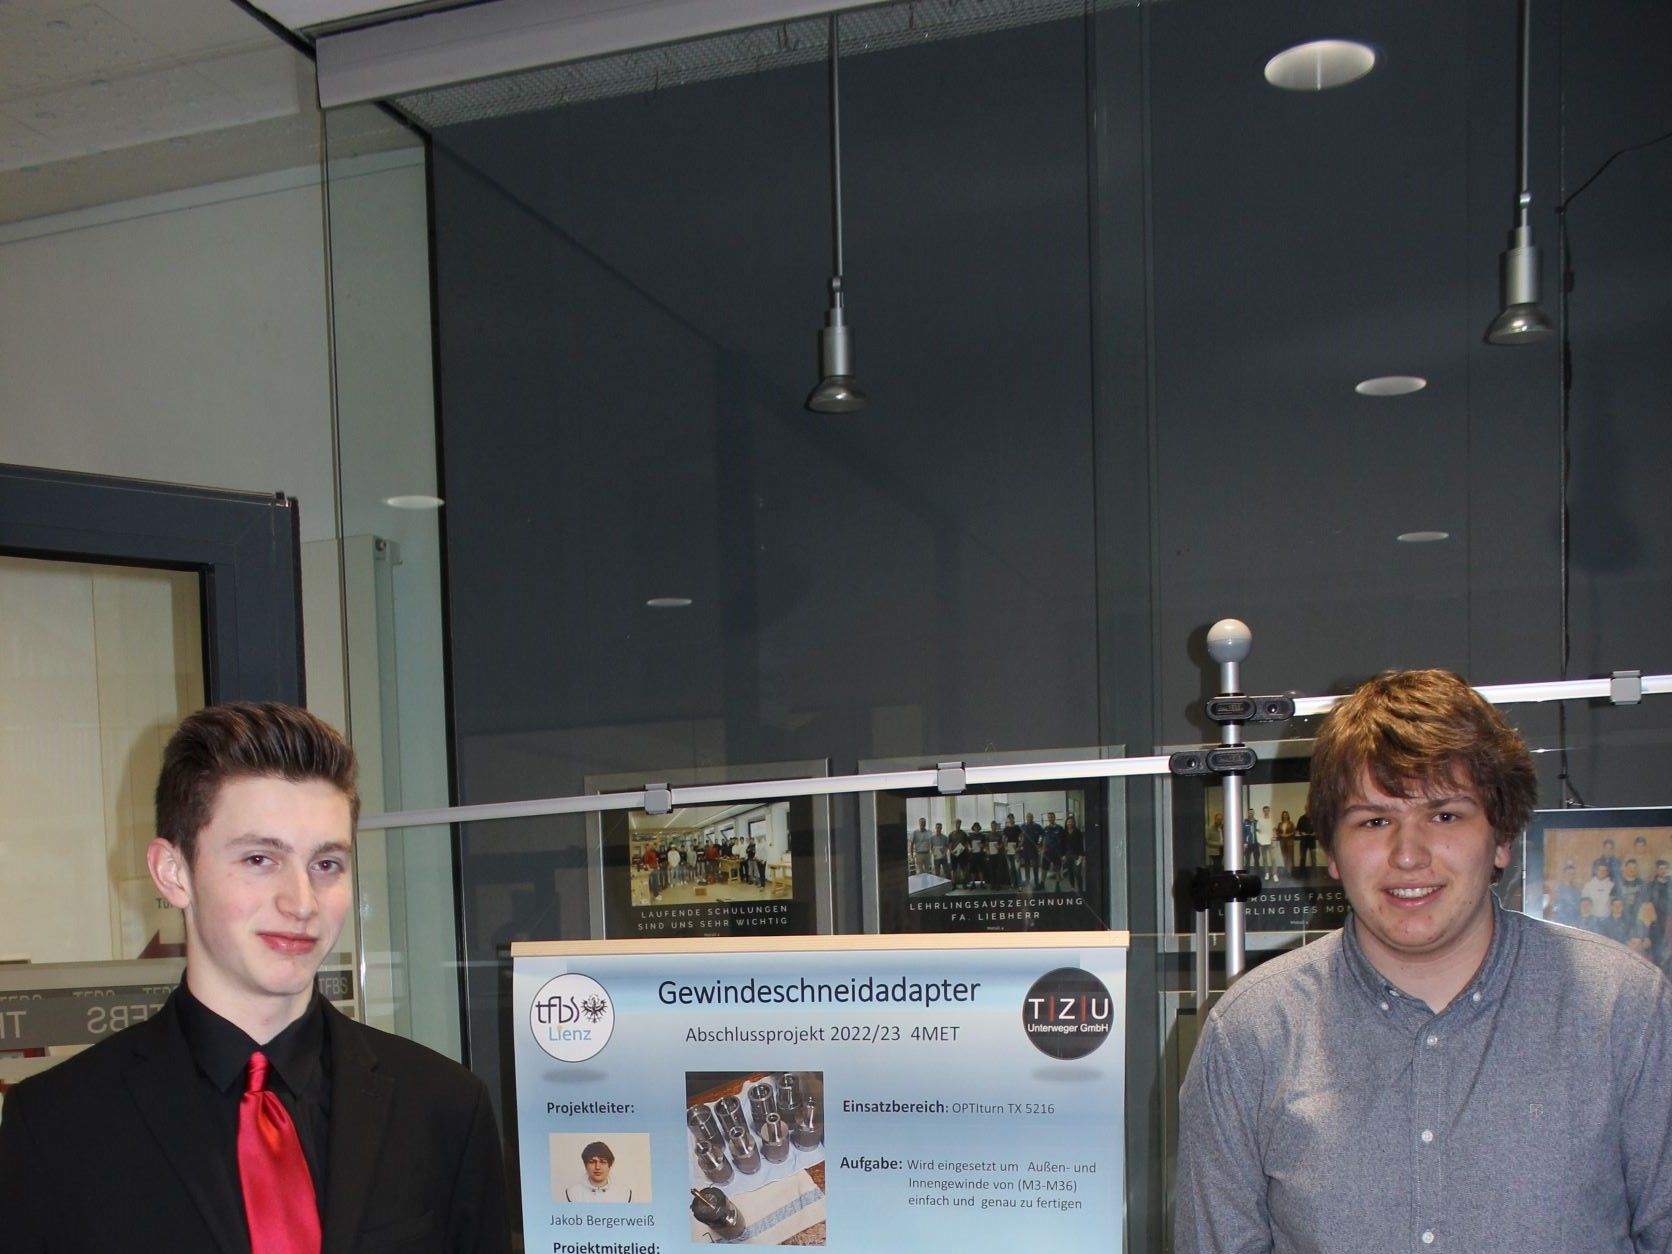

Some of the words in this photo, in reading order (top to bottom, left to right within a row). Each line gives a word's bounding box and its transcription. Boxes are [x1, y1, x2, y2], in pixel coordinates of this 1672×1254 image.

[641, 908, 701, 919] LAUFENDE
[707, 905, 788, 916] SCHULUNGEN
[909, 897, 1083, 911] LEHRLINGSAUSZEICHNUNG
[1293, 905, 1319, 915] DES
[637, 922, 665, 931] SIND
[671, 920, 694, 930] UNS
[700, 919, 730, 928] SEHR
[736, 917, 788, 927] WICHTIG
[951, 913, 971, 922] FA.
[978, 911, 1041, 921] LIEBHERR
[658, 976, 981, 1007] Gewindeschneidadapter
[548, 1025, 592, 1041] Lienz
[686, 1025, 825, 1045] Abschlussprojekt
[830, 1025, 901, 1043] 2022/23
[910, 1025, 961, 1042] 4MET
[1027, 1023, 1079, 1035] Unterweger
[1080, 1023, 1109, 1033] GmbH
[547, 1101, 635, 1117] Projektleiter:
[843, 1099, 949, 1114] Einsatzbereich:
[952, 1103, 1005, 1114] OPTIturn
[1007, 1103, 1023, 1114] TX
[1025, 1103, 1056, 1115] 5216
[840, 1156, 903, 1171] Aufgabe:
[907, 1159, 935, 1172] Wird
[937, 1160, 997, 1174] eingesetzt
[1000, 1163, 1019, 1172] um
[1027, 1160, 1071, 1173] Außen-
[1073, 1161, 1097, 1174] und
[909, 1178, 990, 1191] Innengewinde
[993, 1180, 1014, 1191] von
[1018, 1178, 1078, 1193] (M3-M36)
[908, 1195, 950, 1207] einfach
[953, 1196, 975, 1207] und
[981, 1199, 1017, 1210] genau
[1020, 1199, 1033, 1208] zu
[1036, 1197, 1082, 1211] fertigen
[550, 1213, 583, 1227] Jakob
[586, 1214, 655, 1229] Bergerweiß
